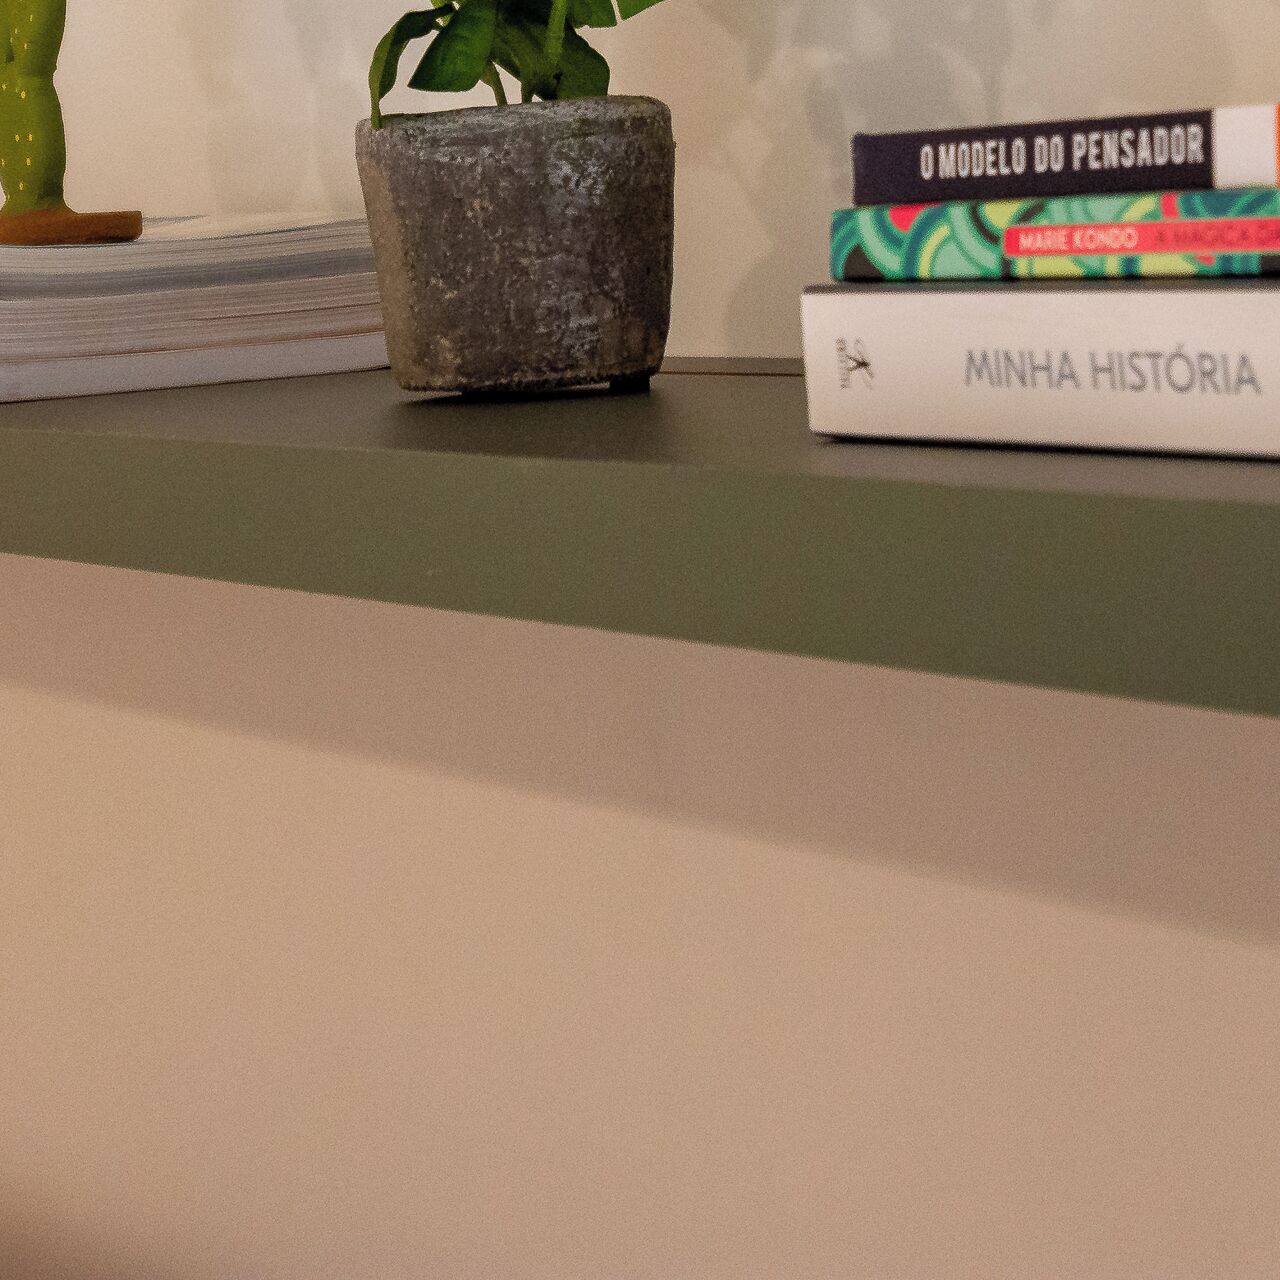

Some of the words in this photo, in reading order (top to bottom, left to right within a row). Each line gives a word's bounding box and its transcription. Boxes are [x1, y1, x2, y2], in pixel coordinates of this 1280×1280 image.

[920, 144, 934, 180] O
[938, 136, 1026, 179] MODELO
[1033, 134, 1065, 173] DO
[1072, 123, 1204, 170] PENSADOR
[1019, 230, 1068, 251] MARIE
[1072, 227, 1139, 250] KONDO
[965, 348, 1080, 390] MINHA
[1089, 342, 1263, 395] HISTÓRIA
